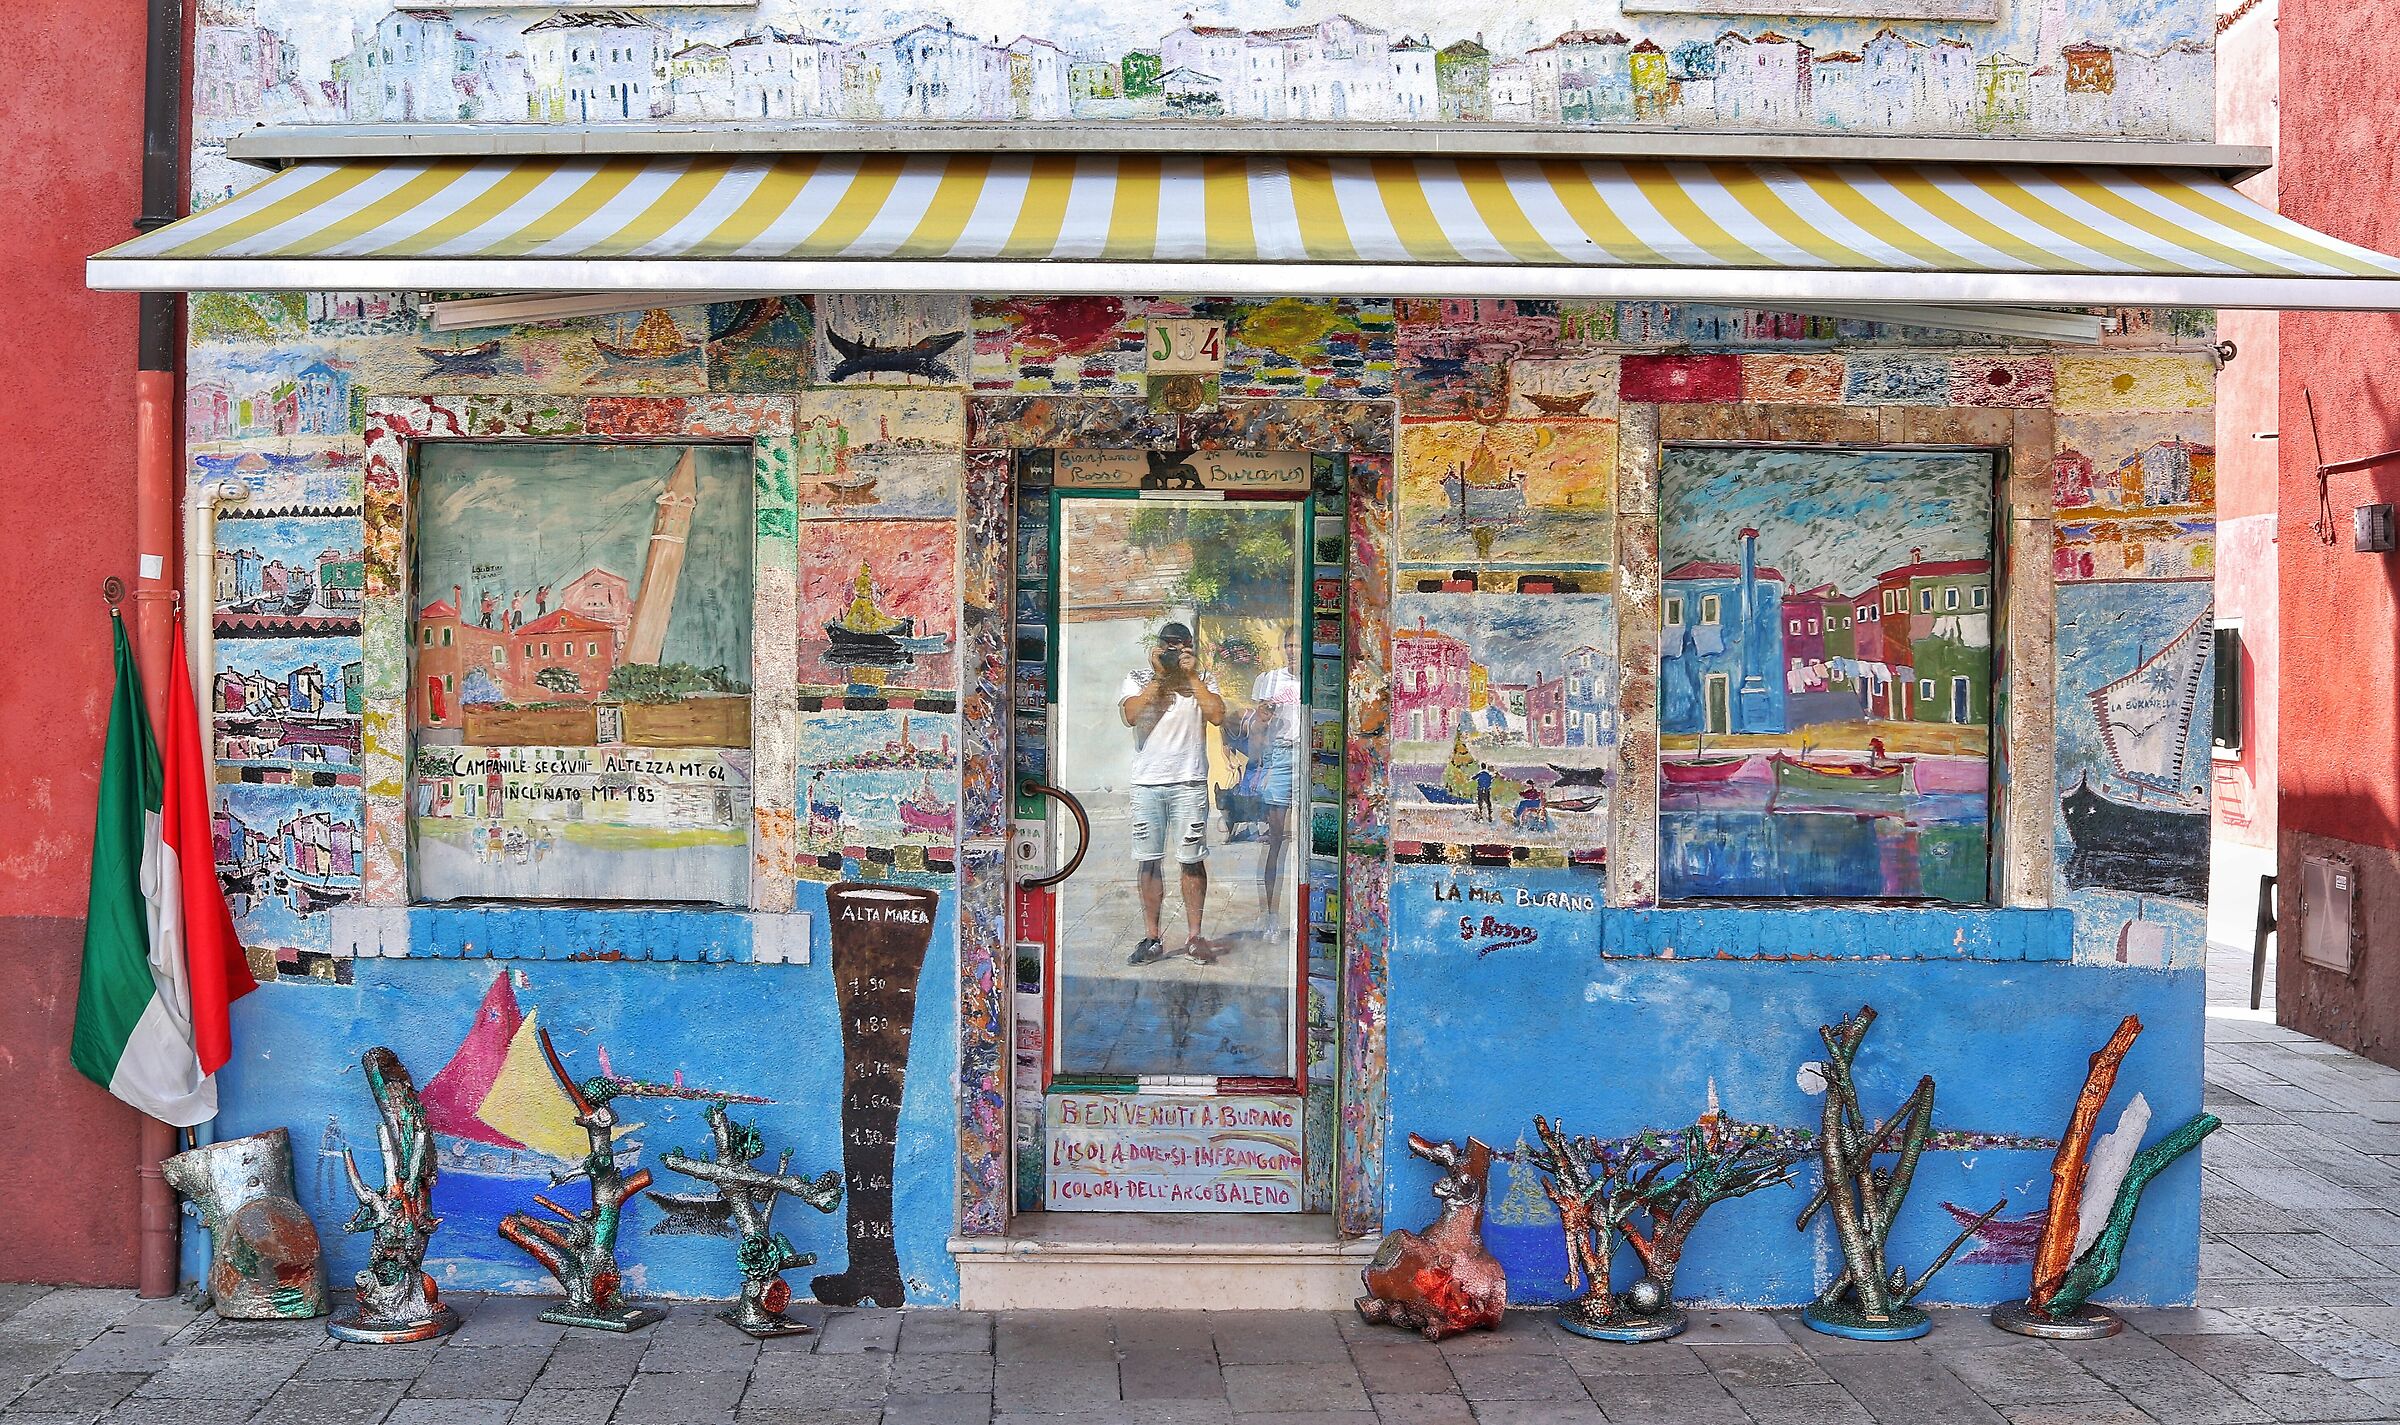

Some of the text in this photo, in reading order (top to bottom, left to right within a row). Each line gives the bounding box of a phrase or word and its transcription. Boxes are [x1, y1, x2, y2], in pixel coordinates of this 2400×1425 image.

[2111, 704, 2122, 712] LA
[605, 756, 675, 774] ALTEZZA
[679, 763, 705, 777] MT.
[708, 766, 725, 782] 64
[504, 785, 655, 802] INCLINATO MT. 1.85
[1019, 806, 1034, 814] LA
[1434, 880, 1594, 912] LA MIA BURANO
[841, 904, 930, 924] ALTA MAREA
[1020, 893, 1029, 942] ITALIA
[1052, 1179, 1057, 1200] I
